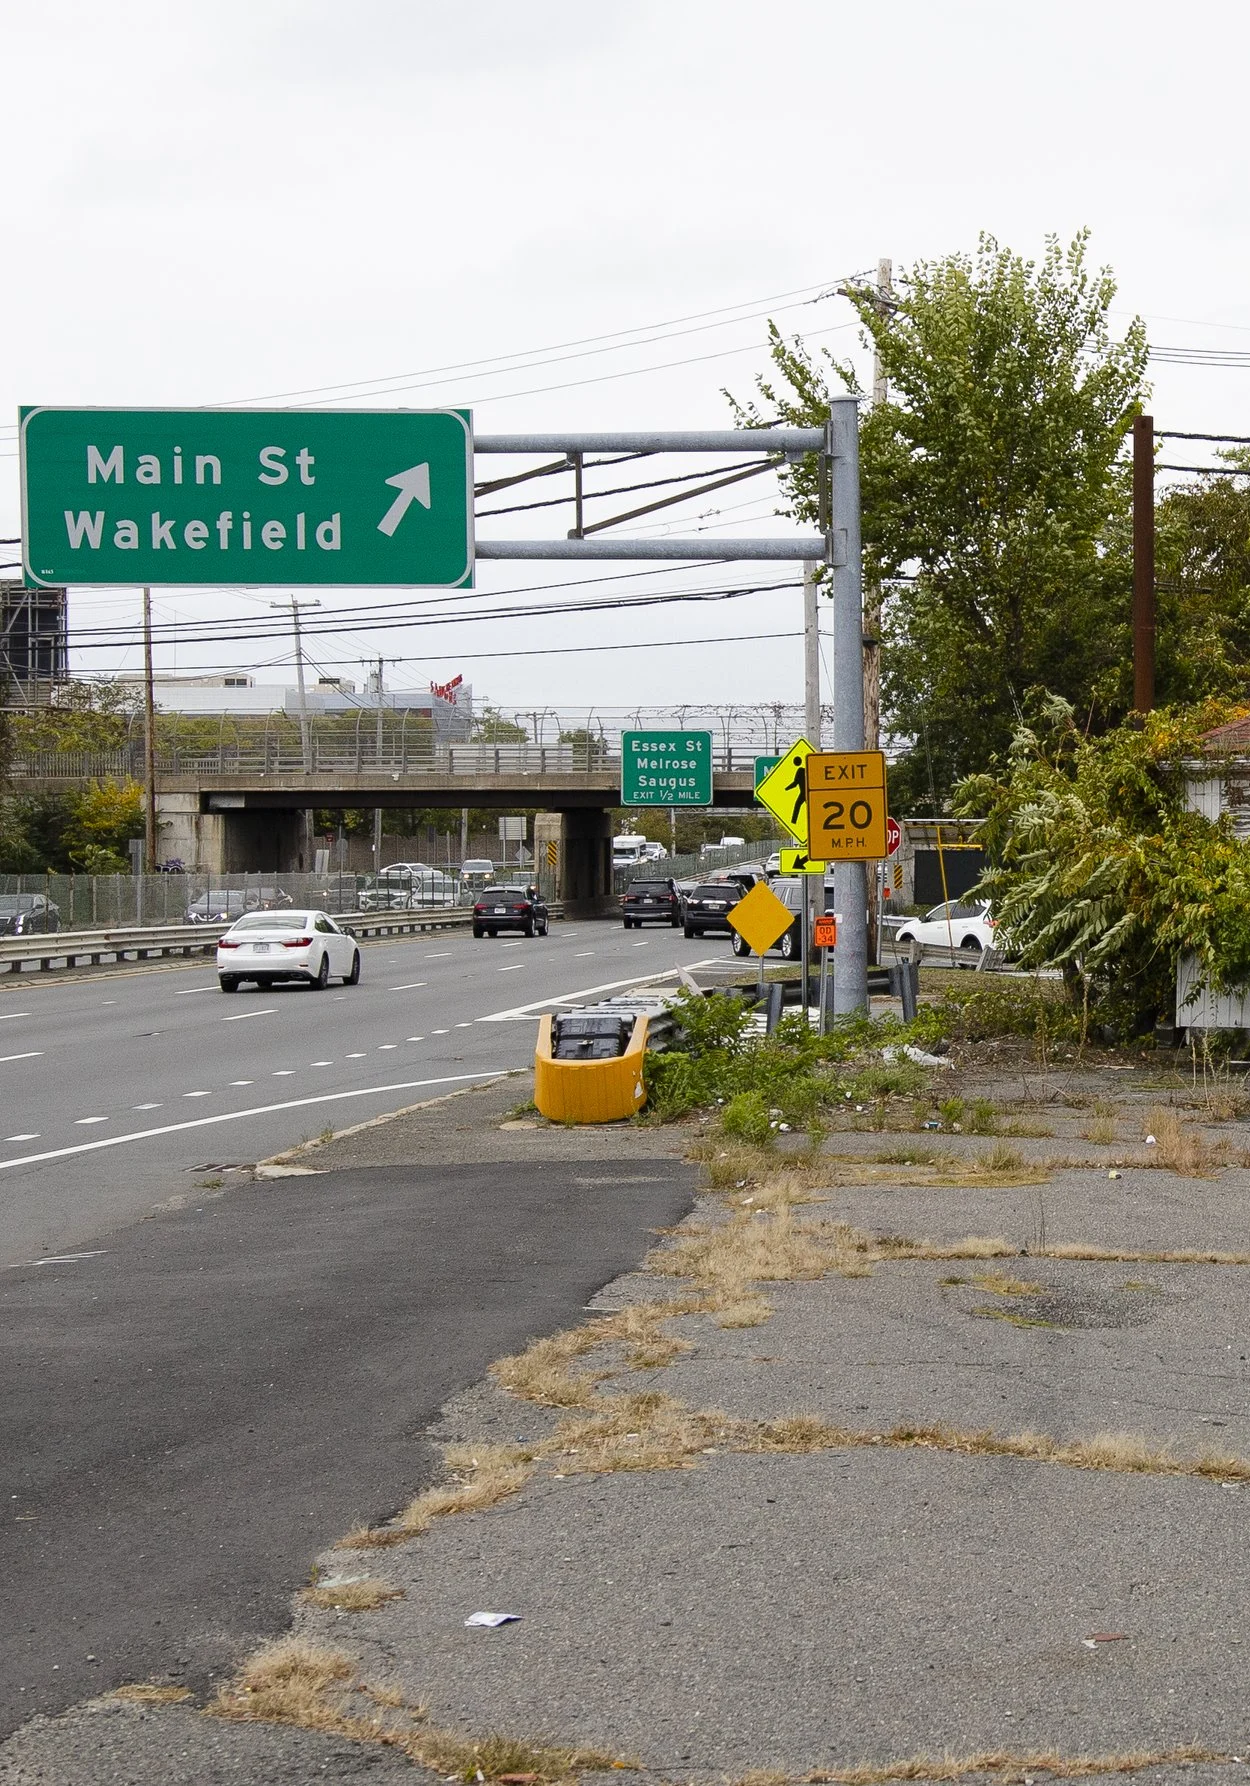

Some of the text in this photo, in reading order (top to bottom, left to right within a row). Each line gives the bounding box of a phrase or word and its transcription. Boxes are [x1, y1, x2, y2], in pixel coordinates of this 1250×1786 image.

[86, 445, 316, 486] Main St
[63, 509, 342, 551] Wakefield
[631, 740, 703, 752] Essex St
[636, 757, 697, 769] Melrose
[824, 764, 868, 780] EXIT
[638, 775, 697, 790] Saugus
[633, 791, 655, 799] EXIT
[678, 791, 701, 799] MILE
[822, 800, 873, 830] 20
